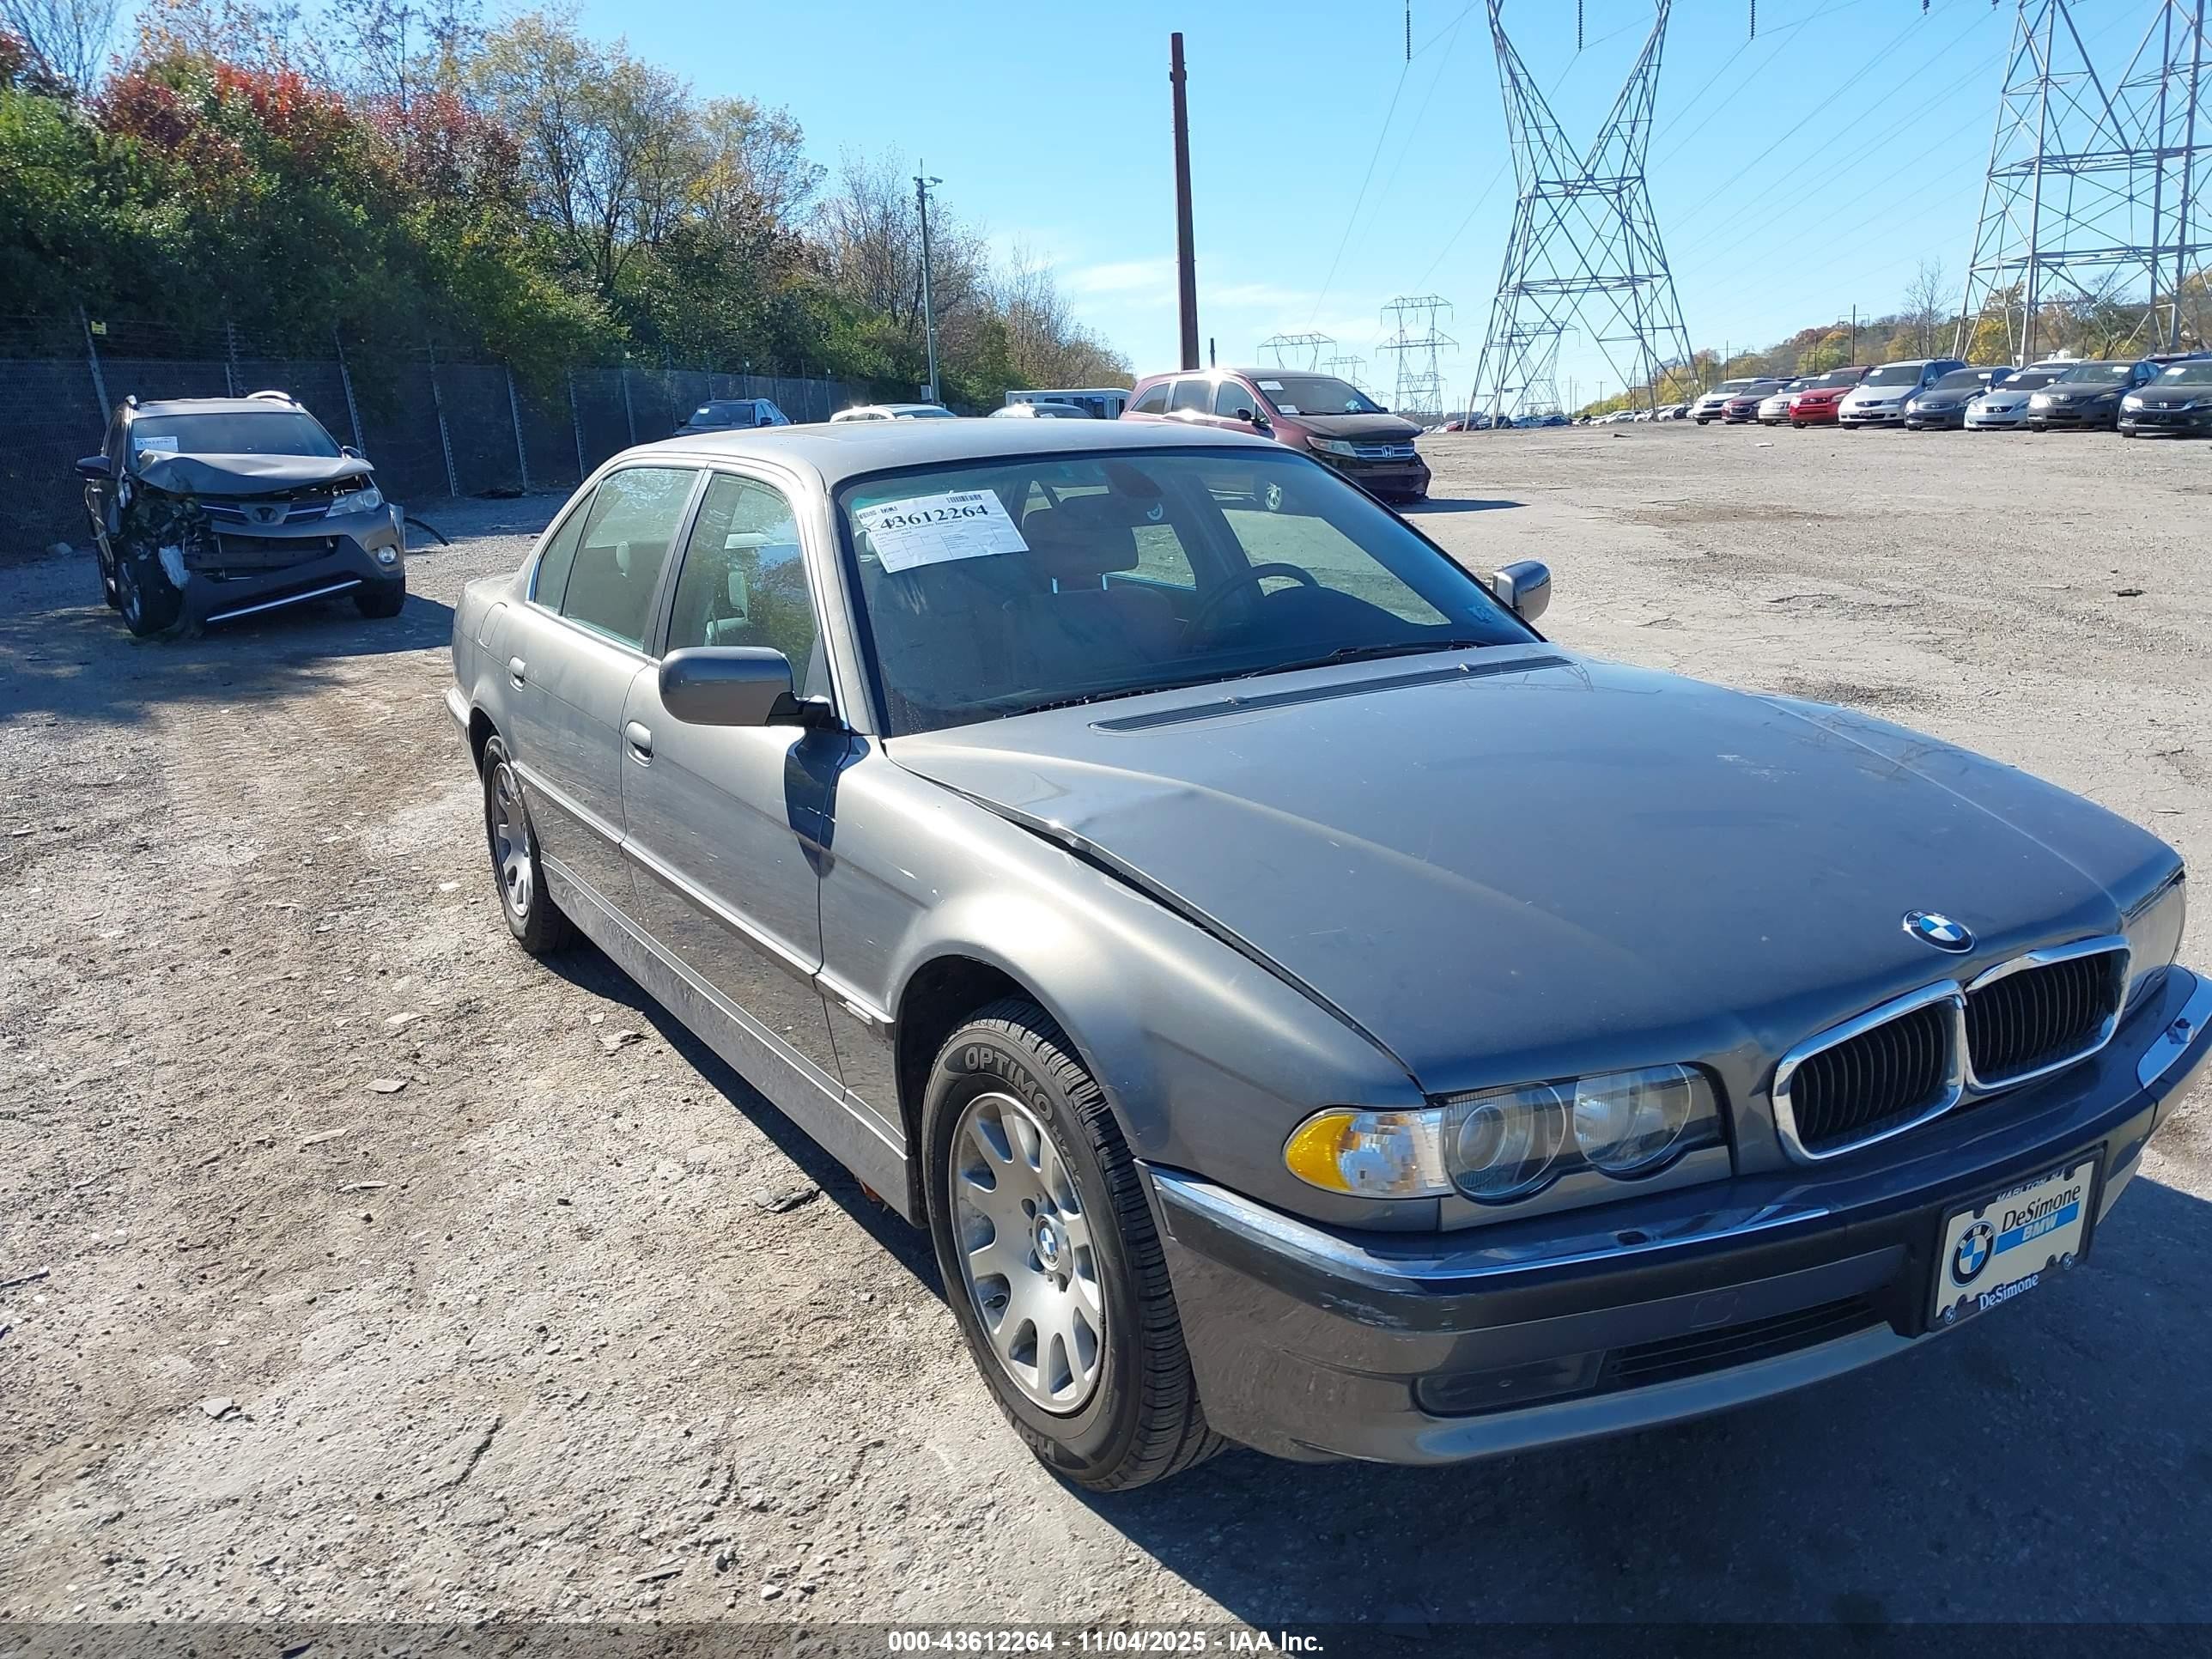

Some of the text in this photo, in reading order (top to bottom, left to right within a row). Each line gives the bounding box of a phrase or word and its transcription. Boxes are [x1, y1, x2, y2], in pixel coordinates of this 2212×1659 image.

[880, 503, 989, 531] 43612264
[964, 1046, 1054, 1121] OPTIMO
[2002, 1185, 2081, 1233] DeSimone
[1958, 1224, 1994, 1250] BMW
[2021, 1212, 2059, 1242] BMW
[1978, 1273, 2040, 1311] DeSimone
